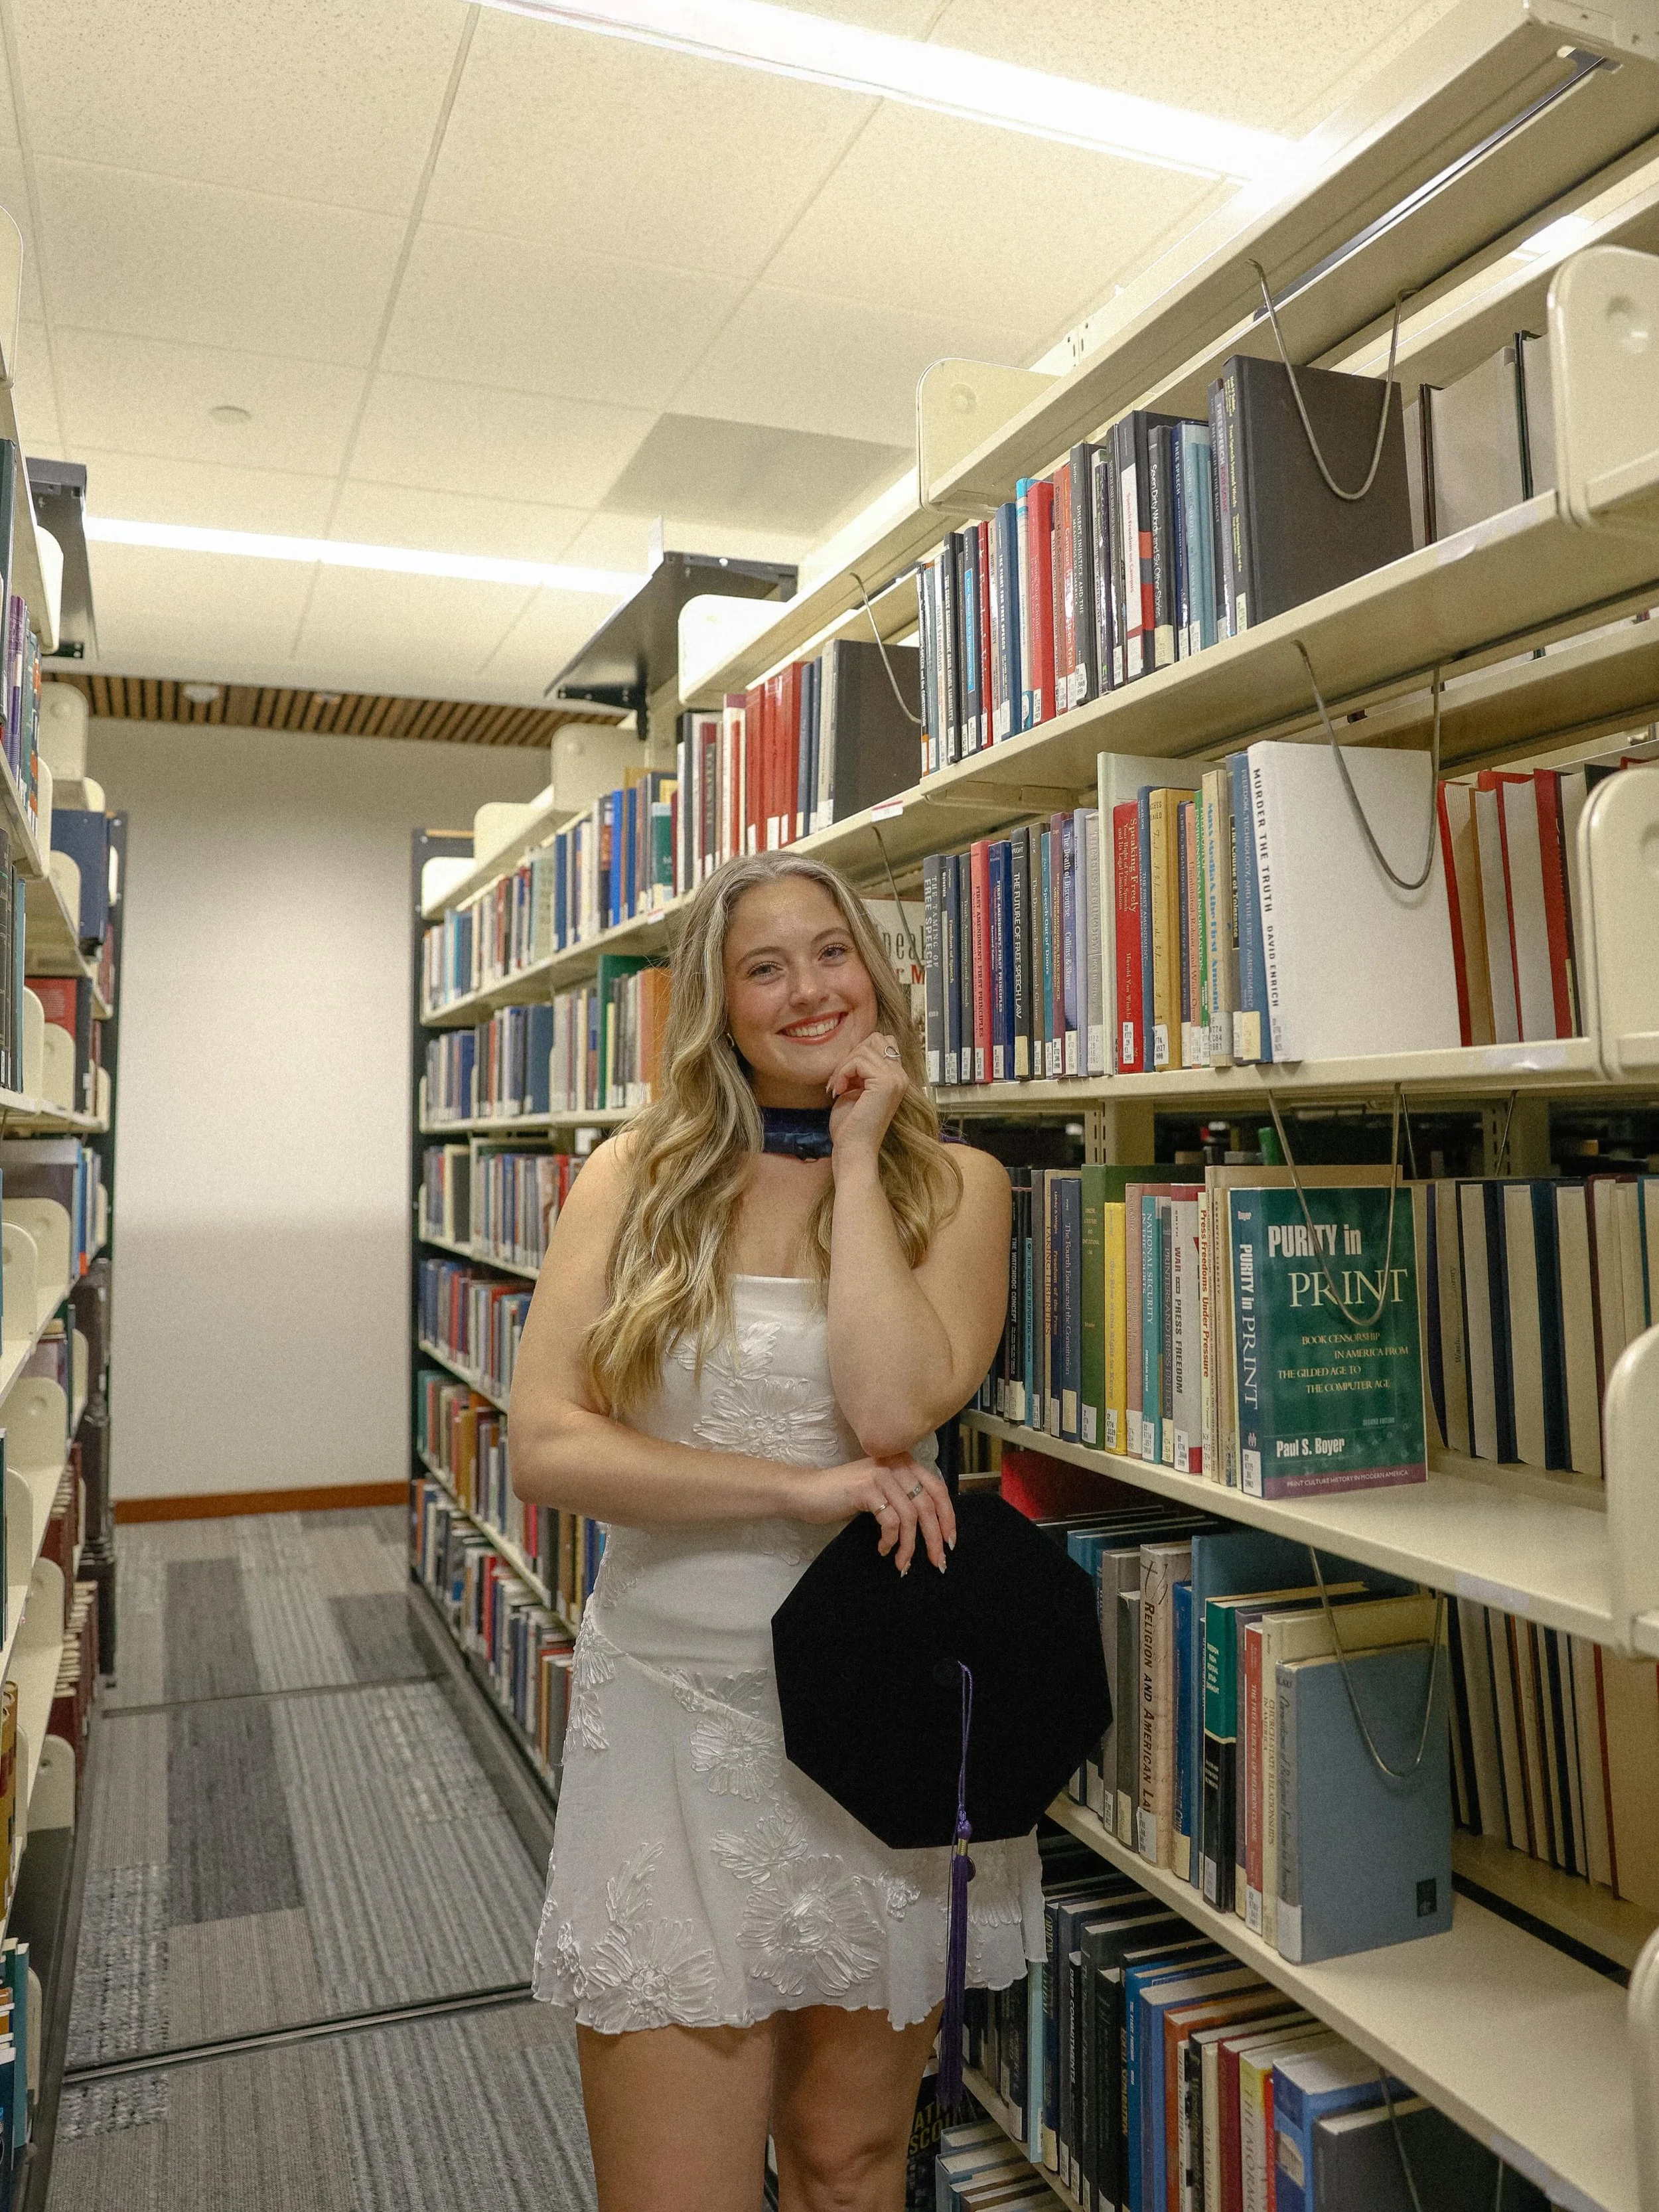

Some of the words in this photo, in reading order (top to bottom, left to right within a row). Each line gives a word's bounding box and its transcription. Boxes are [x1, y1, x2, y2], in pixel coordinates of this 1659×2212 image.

[1151, 510, 1160, 536] Words
[1129, 553, 1133, 562] on
[1253, 768, 1266, 828] MURDER
[1128, 818, 1137, 873] Speaking
[1259, 833, 1269, 860] THE
[1130, 875, 1139, 913] Freely
[1262, 865, 1273, 913] TRUTH
[1015, 925, 1021, 940] OF
[1045, 937, 1050, 947] of
[1267, 925, 1275, 960] DAVID
[933, 954, 938, 968] OF
[1269, 964, 1279, 1007] ENRICH
[1237, 1211, 1253, 1221] Boyer
[1267, 1224, 1338, 1258] PURITY
[1343, 1224, 1362, 1256] in
[1239, 1244, 1255, 1293] PURITY
[1287, 1268, 1409, 1308] PRINT
[1241, 1296, 1255, 1311] in
[1302, 1335, 1327, 1346] BOOK
[1328, 1332, 1381, 1345] CENSORSHIP
[1242, 1315, 1259, 1410] PRINT
[1334, 1350, 1345, 1360] IN
[1345, 1348, 1384, 1359] AMERICA
[1384, 1346, 1409, 1357] FROM
[1278, 1370, 1296, 1380] THE
[1297, 1367, 1329, 1378] GILDED
[1330, 1366, 1348, 1376] AGE
[1348, 1365, 1362, 1374] TO
[1305, 1384, 1323, 1394] THE
[1324, 1381, 1374, 1392] COMPUTER
[1374, 1379, 1392, 1389] AGE
[1276, 1439, 1300, 1458] Paul
[1301, 1438, 1313, 1455] S.
[1314, 1438, 1346, 1457] Boyer
[1304, 1477, 1331, 1486] CULTURE
[1331, 1475, 1354, 1484] HISTORY
[1360, 1471, 1386, 1480] MODERN
[1143, 1601, 1155, 1668] RELIGION
[1143, 1672, 1153, 1702] AND
[1263, 1696, 1268, 1710] IN
[1143, 1707, 1155, 1784] AMERICAN
[1280, 1752, 1289, 1766] of
[1251, 1762, 1258, 1773] OF
[1280, 1766, 1290, 1805] Religious
[1281, 1806, 1291, 1847] Freedom
[1244, 2089, 1254, 2126] THE
